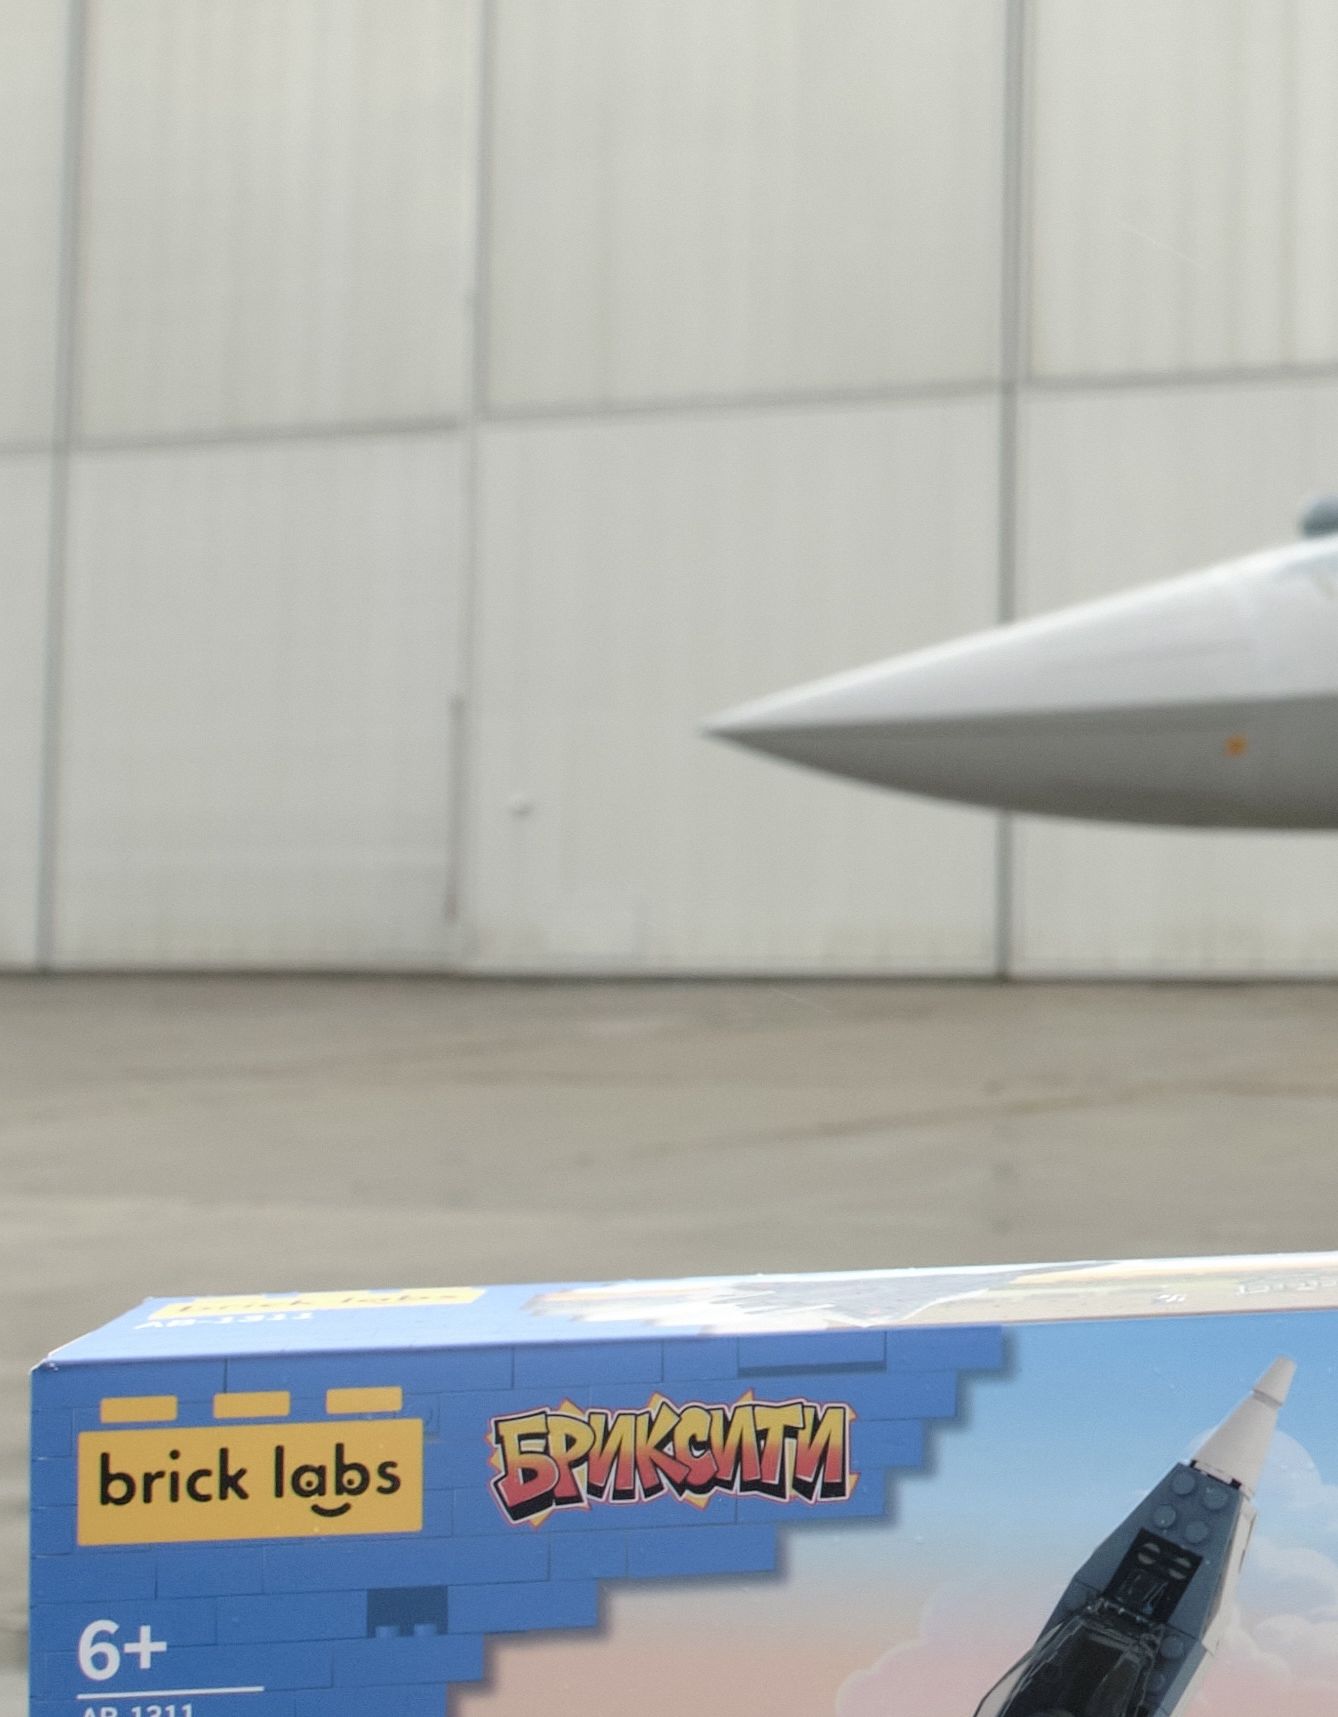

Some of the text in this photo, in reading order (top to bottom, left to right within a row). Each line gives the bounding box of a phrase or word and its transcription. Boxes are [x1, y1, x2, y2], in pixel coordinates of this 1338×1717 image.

[100, 1443, 402, 1506] brick labs
[495, 1398, 852, 1524] БРИКСИТИ
[78, 1619, 168, 1682] 6+
